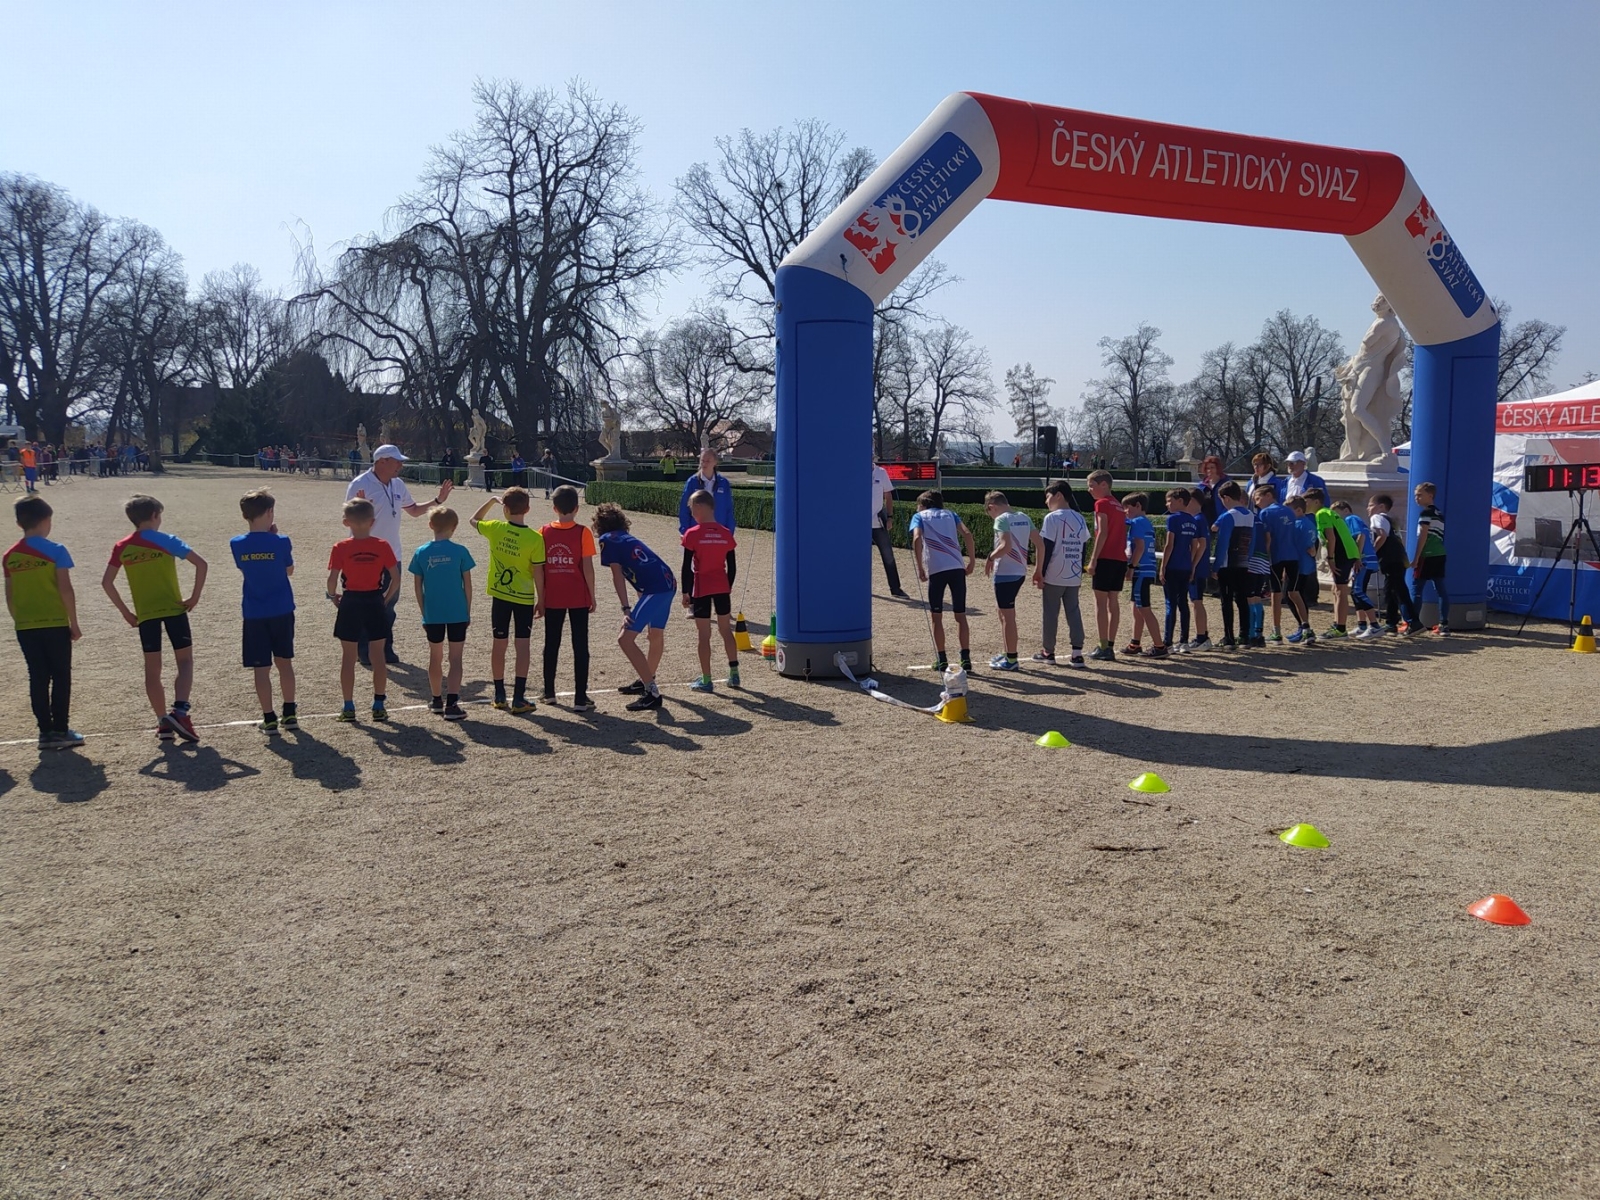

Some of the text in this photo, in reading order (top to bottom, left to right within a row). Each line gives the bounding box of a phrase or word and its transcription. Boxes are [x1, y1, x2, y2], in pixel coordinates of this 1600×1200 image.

[1051, 119, 1360, 202] ČESKÝ ATLETICKÝ SVAZ
[897, 158, 935, 195] ČESKÝ
[912, 145, 969, 208] ATLETICKÝ
[922, 187, 952, 220] SVAZ
[1438, 260, 1460, 289] SVAZ
[1502, 402, 1556, 427] ČESKÝ
[495, 546, 521, 558] ATLETIKA
[498, 541, 520, 551] VYŠKOV
[503, 536, 519, 545] OREL
[1495, 593, 1513, 601] SVAZ
